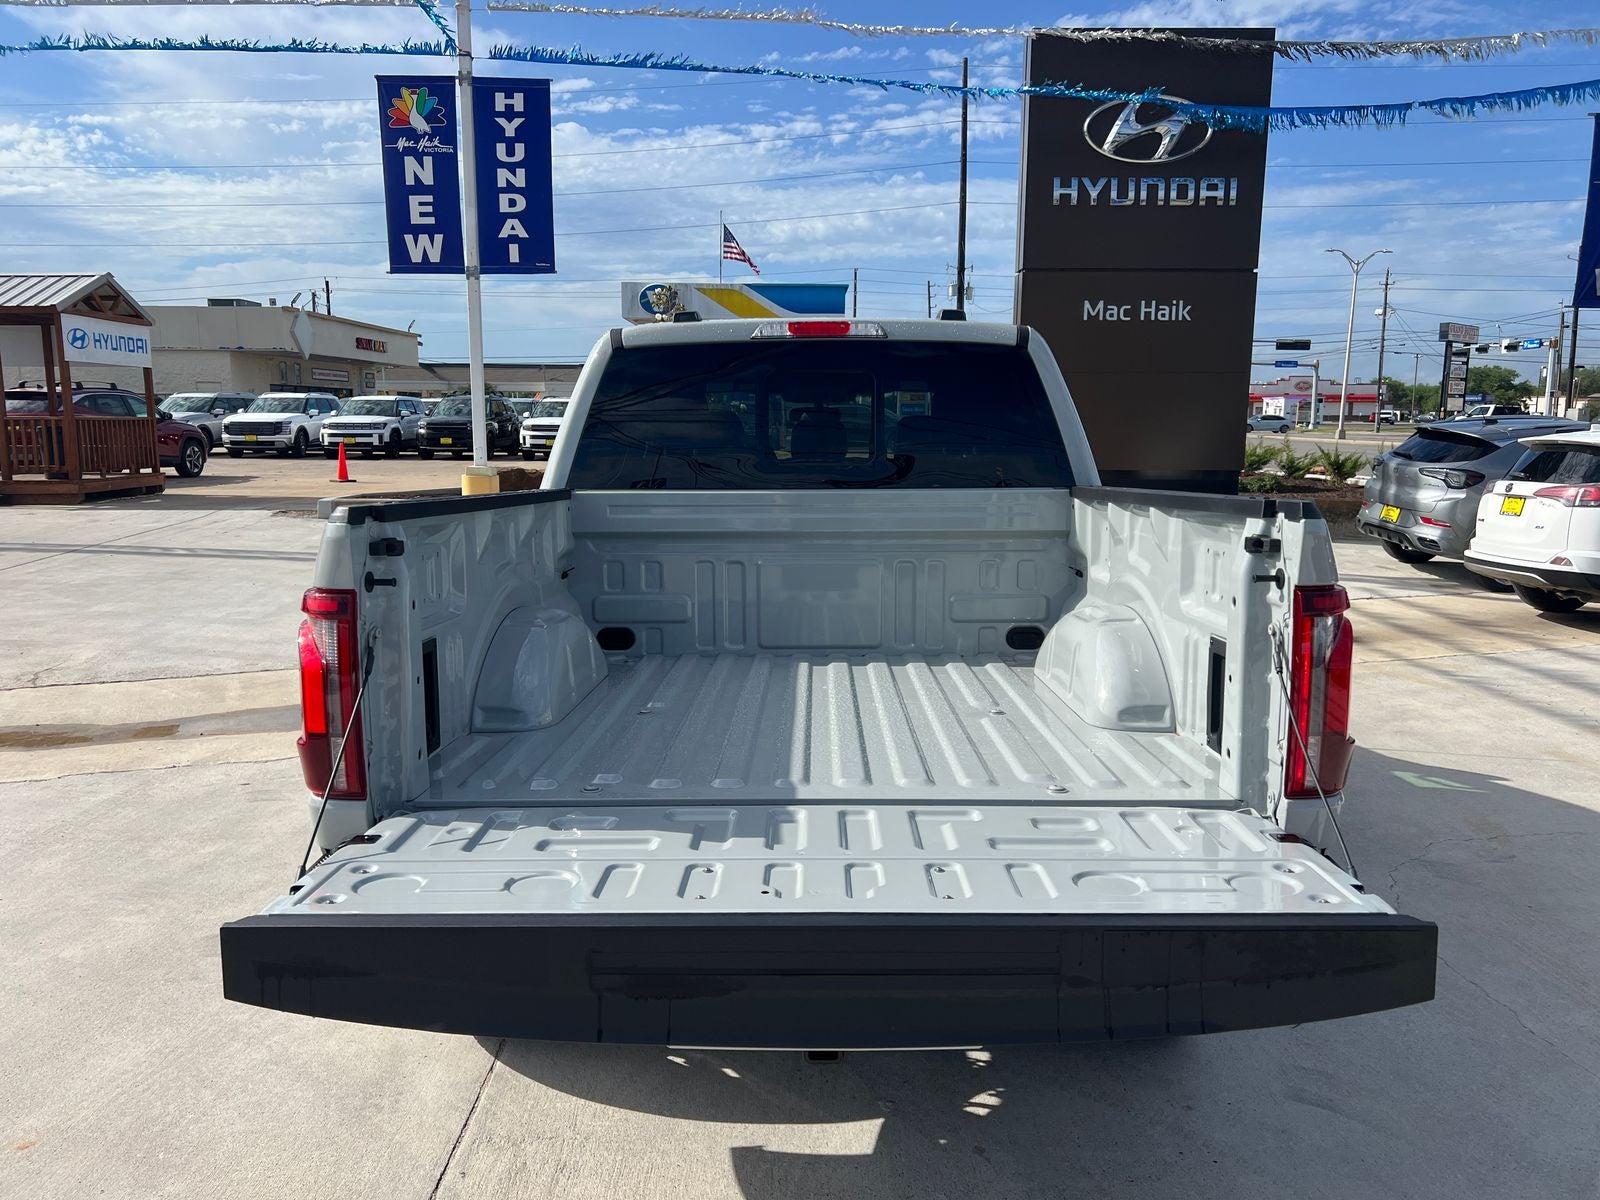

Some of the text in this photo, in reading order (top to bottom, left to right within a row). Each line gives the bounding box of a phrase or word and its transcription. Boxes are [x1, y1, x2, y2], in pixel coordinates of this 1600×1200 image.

[391, 135, 446, 152] Mac Haik
[494, 92, 529, 263] HYUNDAI
[1053, 176, 1237, 206] HYUNDAI
[404, 156, 444, 263] NEW
[1083, 299, 1192, 321] Mac Haik
[92, 332, 148, 354] HYUNDAI
